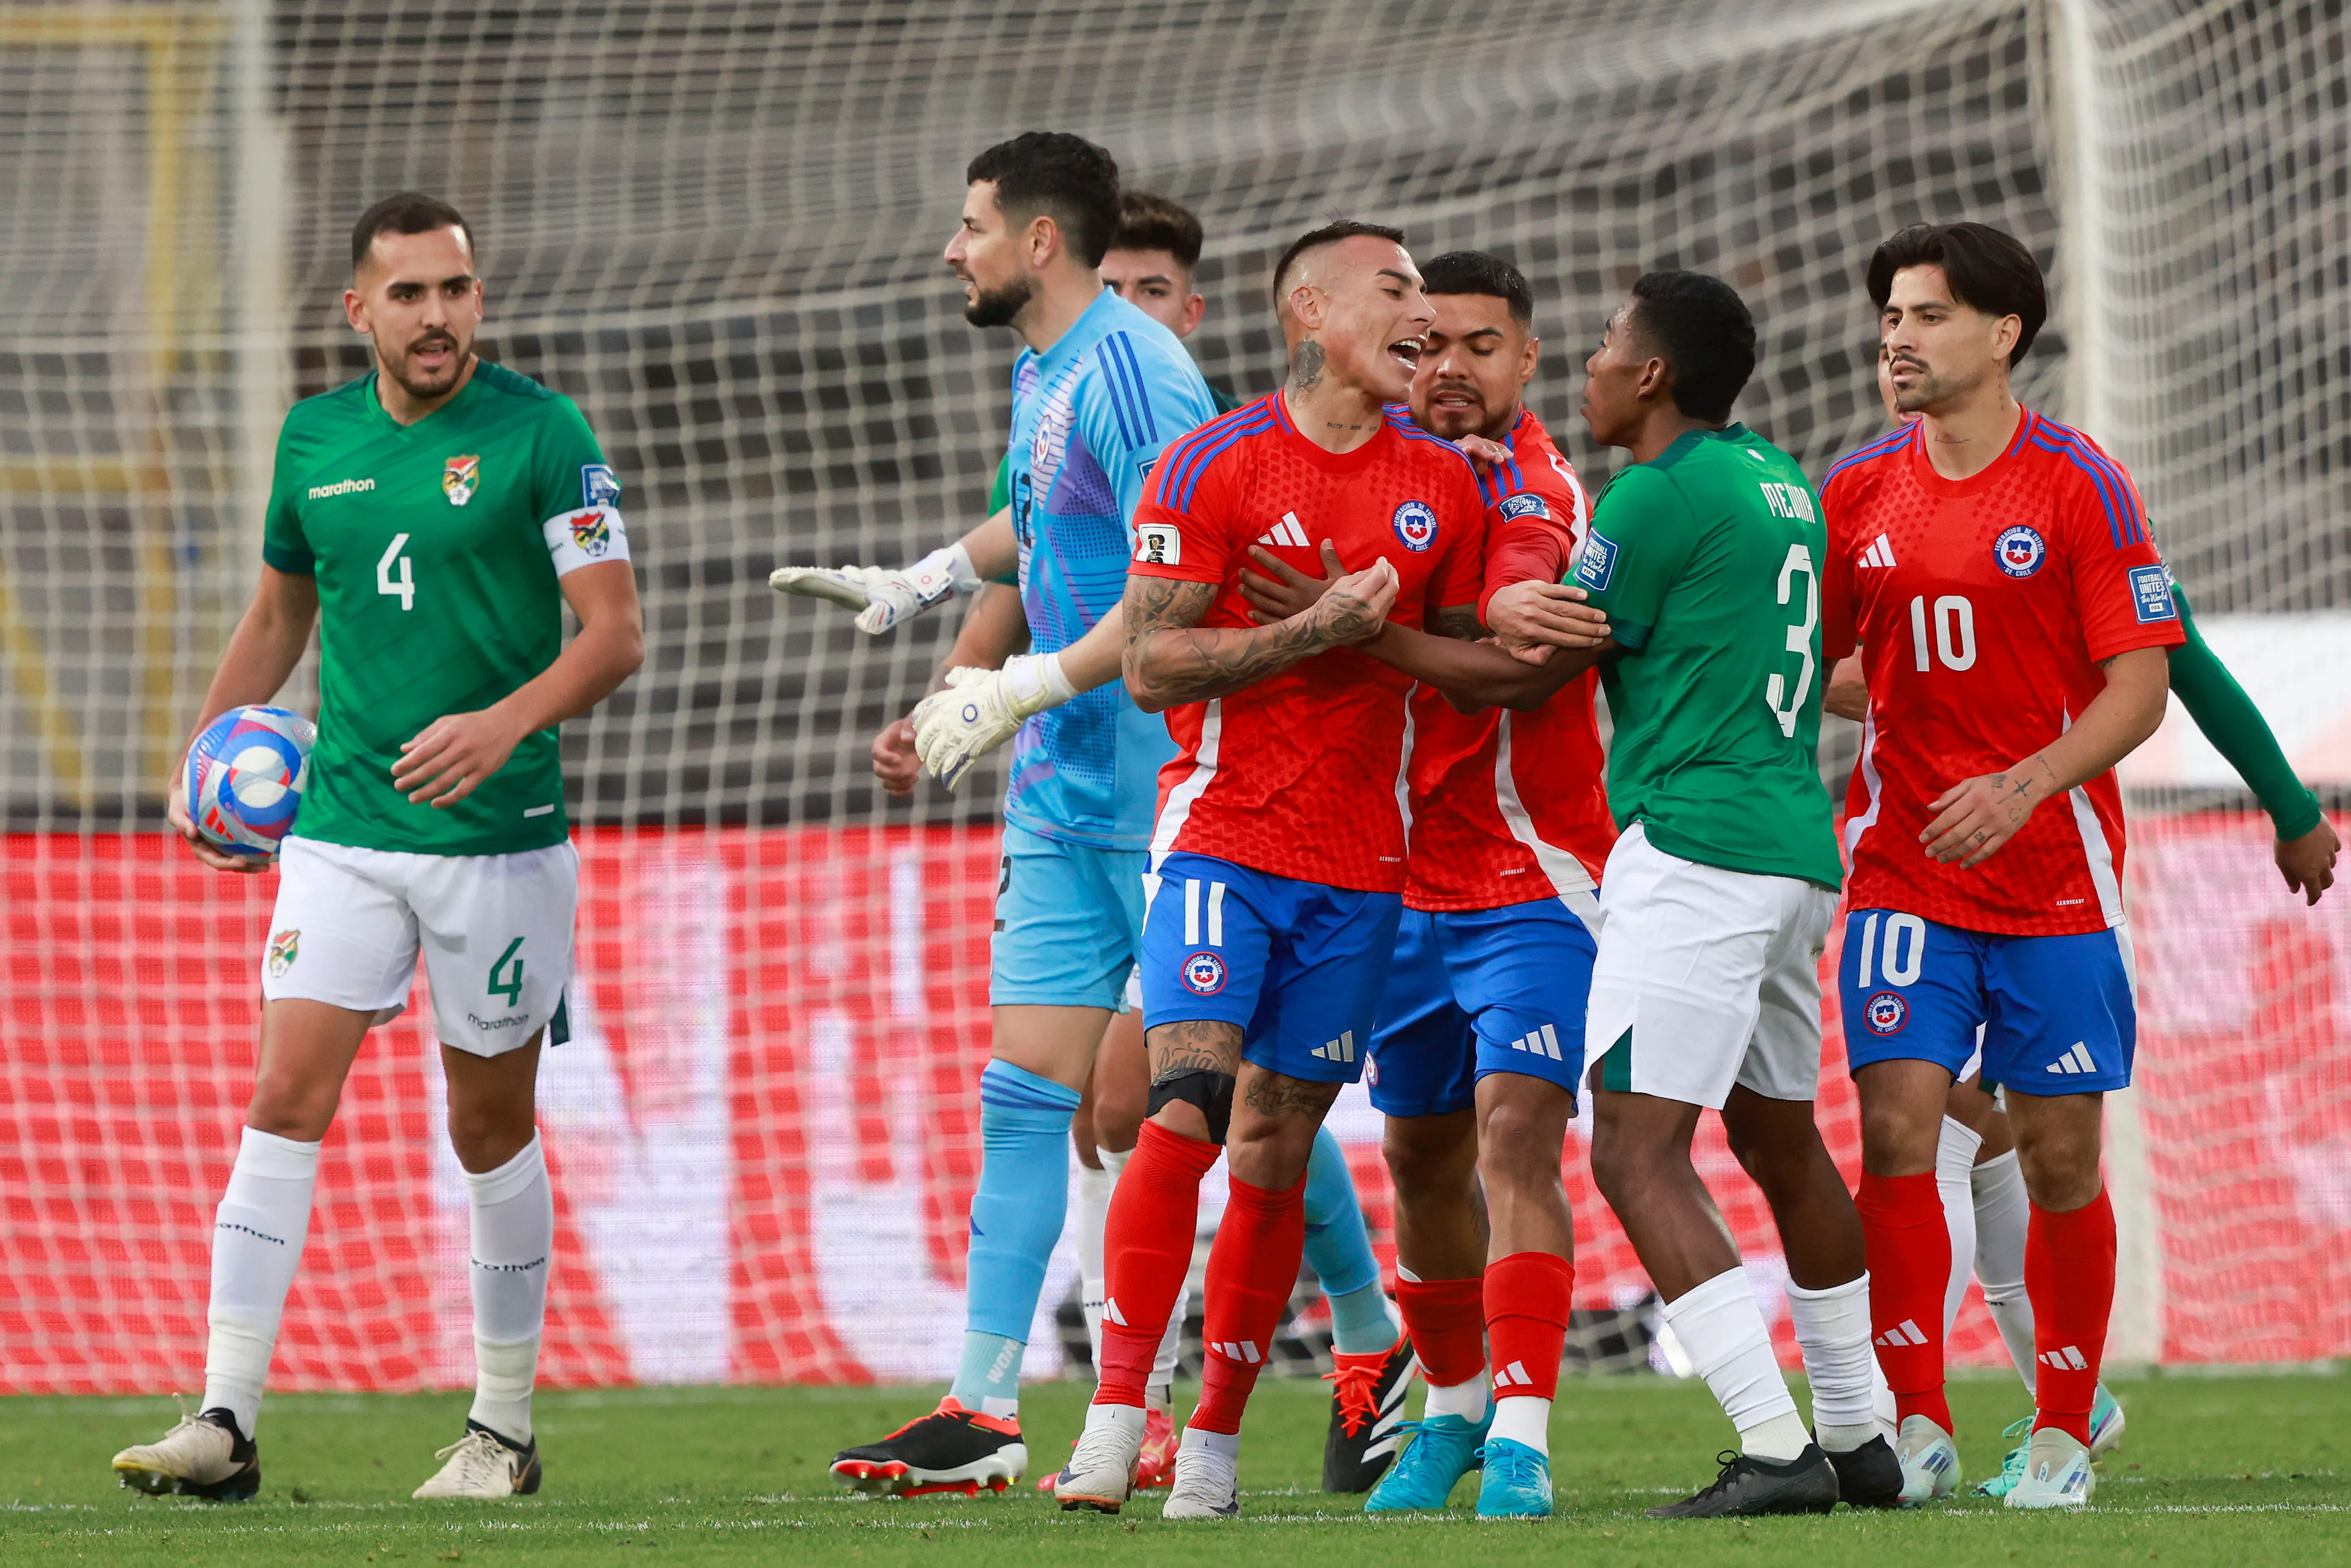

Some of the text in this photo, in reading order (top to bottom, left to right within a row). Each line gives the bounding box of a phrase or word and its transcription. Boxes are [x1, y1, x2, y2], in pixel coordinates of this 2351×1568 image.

[309, 478, 375, 500] marathon
[1588, 537, 1608, 556] FOOTBALL
[2032, 533, 2045, 554] FUTBOL
[1585, 544, 1607, 565] UNITES
[377, 533, 415, 610] 4
[1583, 568, 1594, 577] FIFA
[1587, 558, 1606, 575] World
[2016, 568, 2032, 577] CHILE
[2137, 573, 2162, 584] FOOTBALL
[2139, 581, 2165, 594] UNITES
[2140, 591, 2168, 604] the World
[1766, 543, 1818, 738] 3
[1911, 595, 1976, 672] 10
[1185, 879, 1226, 946] 11
[1858, 913, 1925, 988] 10
[487, 936, 525, 1007] 4
[468, 1013, 529, 1030] marathon
